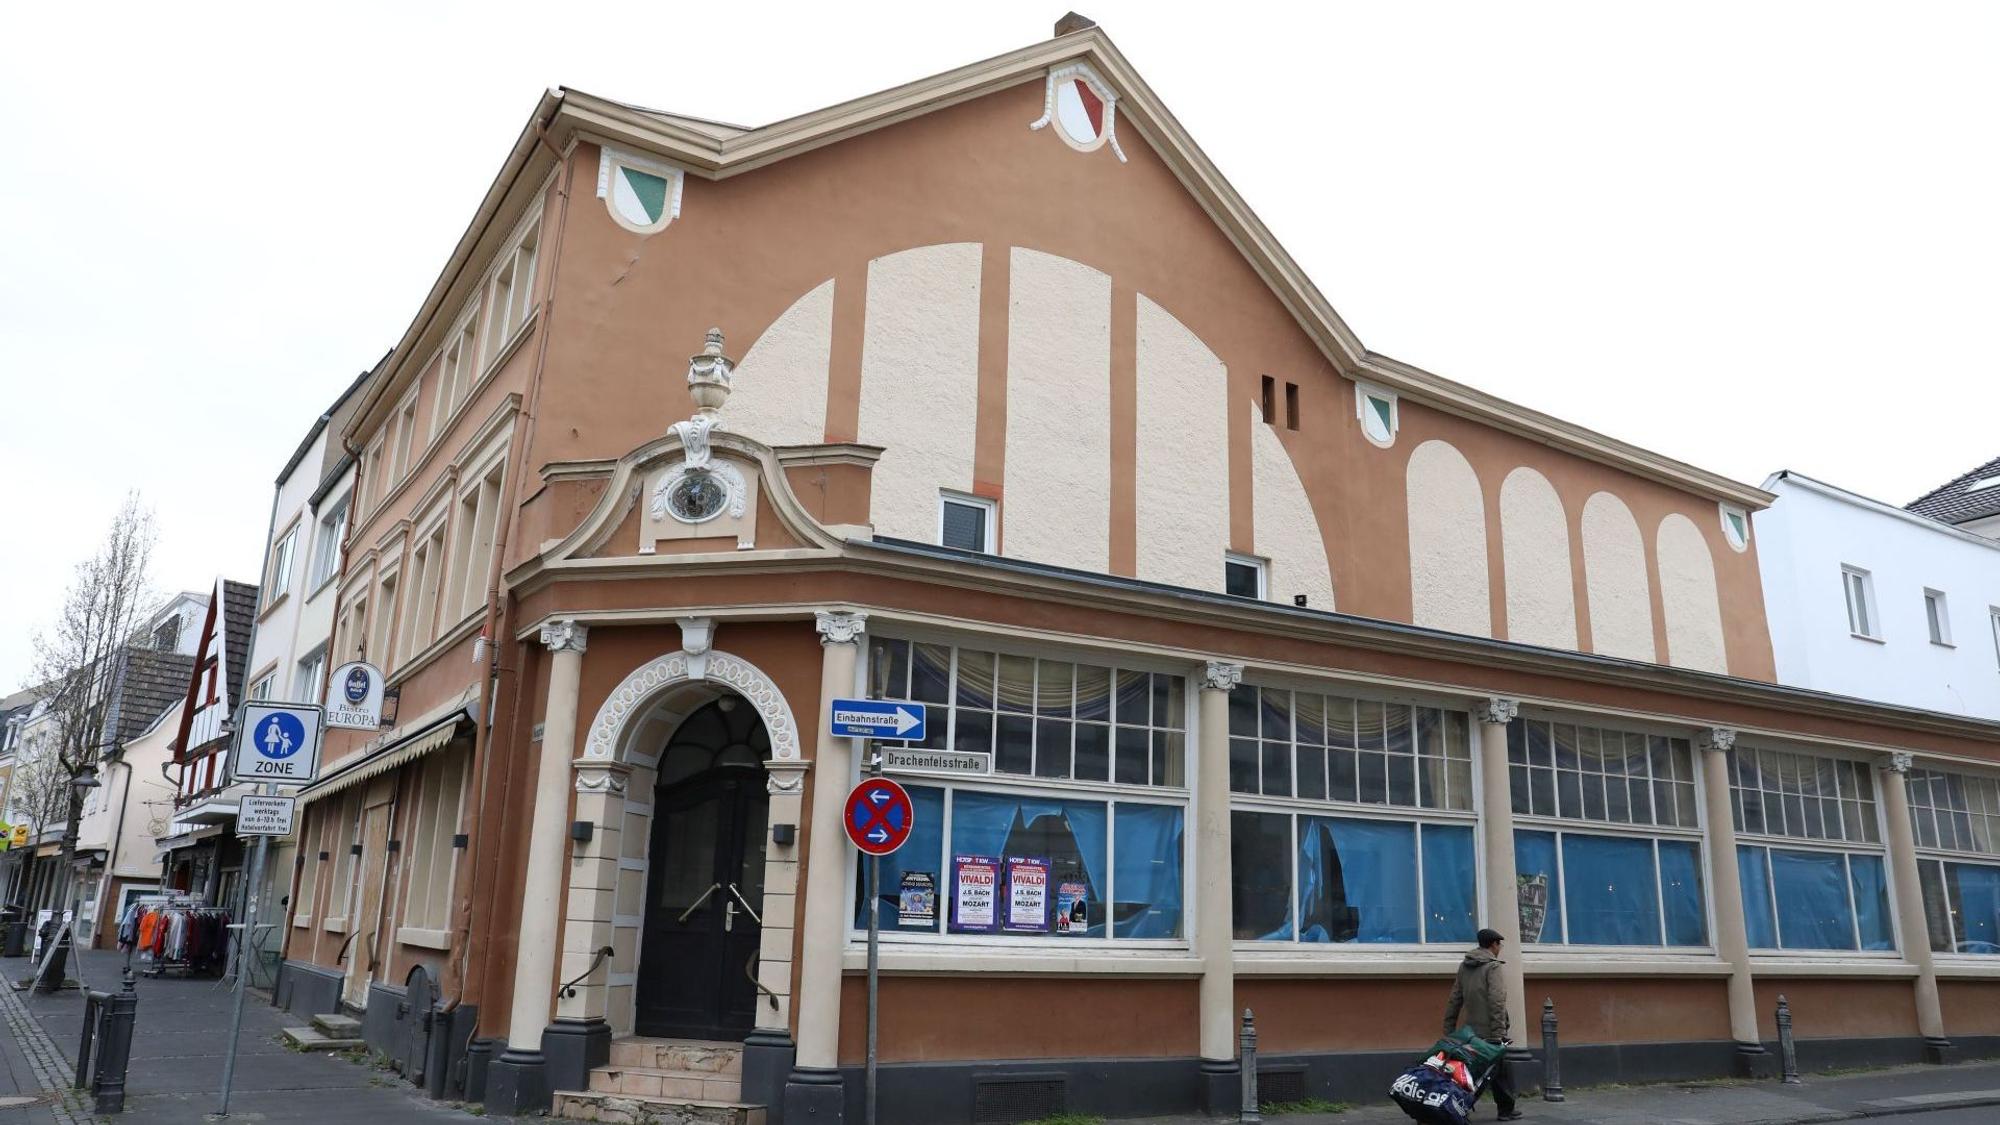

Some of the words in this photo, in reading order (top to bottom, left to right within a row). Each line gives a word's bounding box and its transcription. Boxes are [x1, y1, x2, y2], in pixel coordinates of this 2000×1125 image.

[340, 704, 369, 713] Bistro
[328, 711, 376, 727] EUROPA
[836, 712, 899, 725] Einbahnstraße
[888, 753, 980, 770] Drachenfelsstraße
[255, 761, 295, 775] ZONE
[960, 875, 993, 885] VIVALDI
[1013, 875, 1045, 885] VIVALDI
[962, 900, 989, 908] MOZART
[1015, 900, 1041, 908] MOZART
